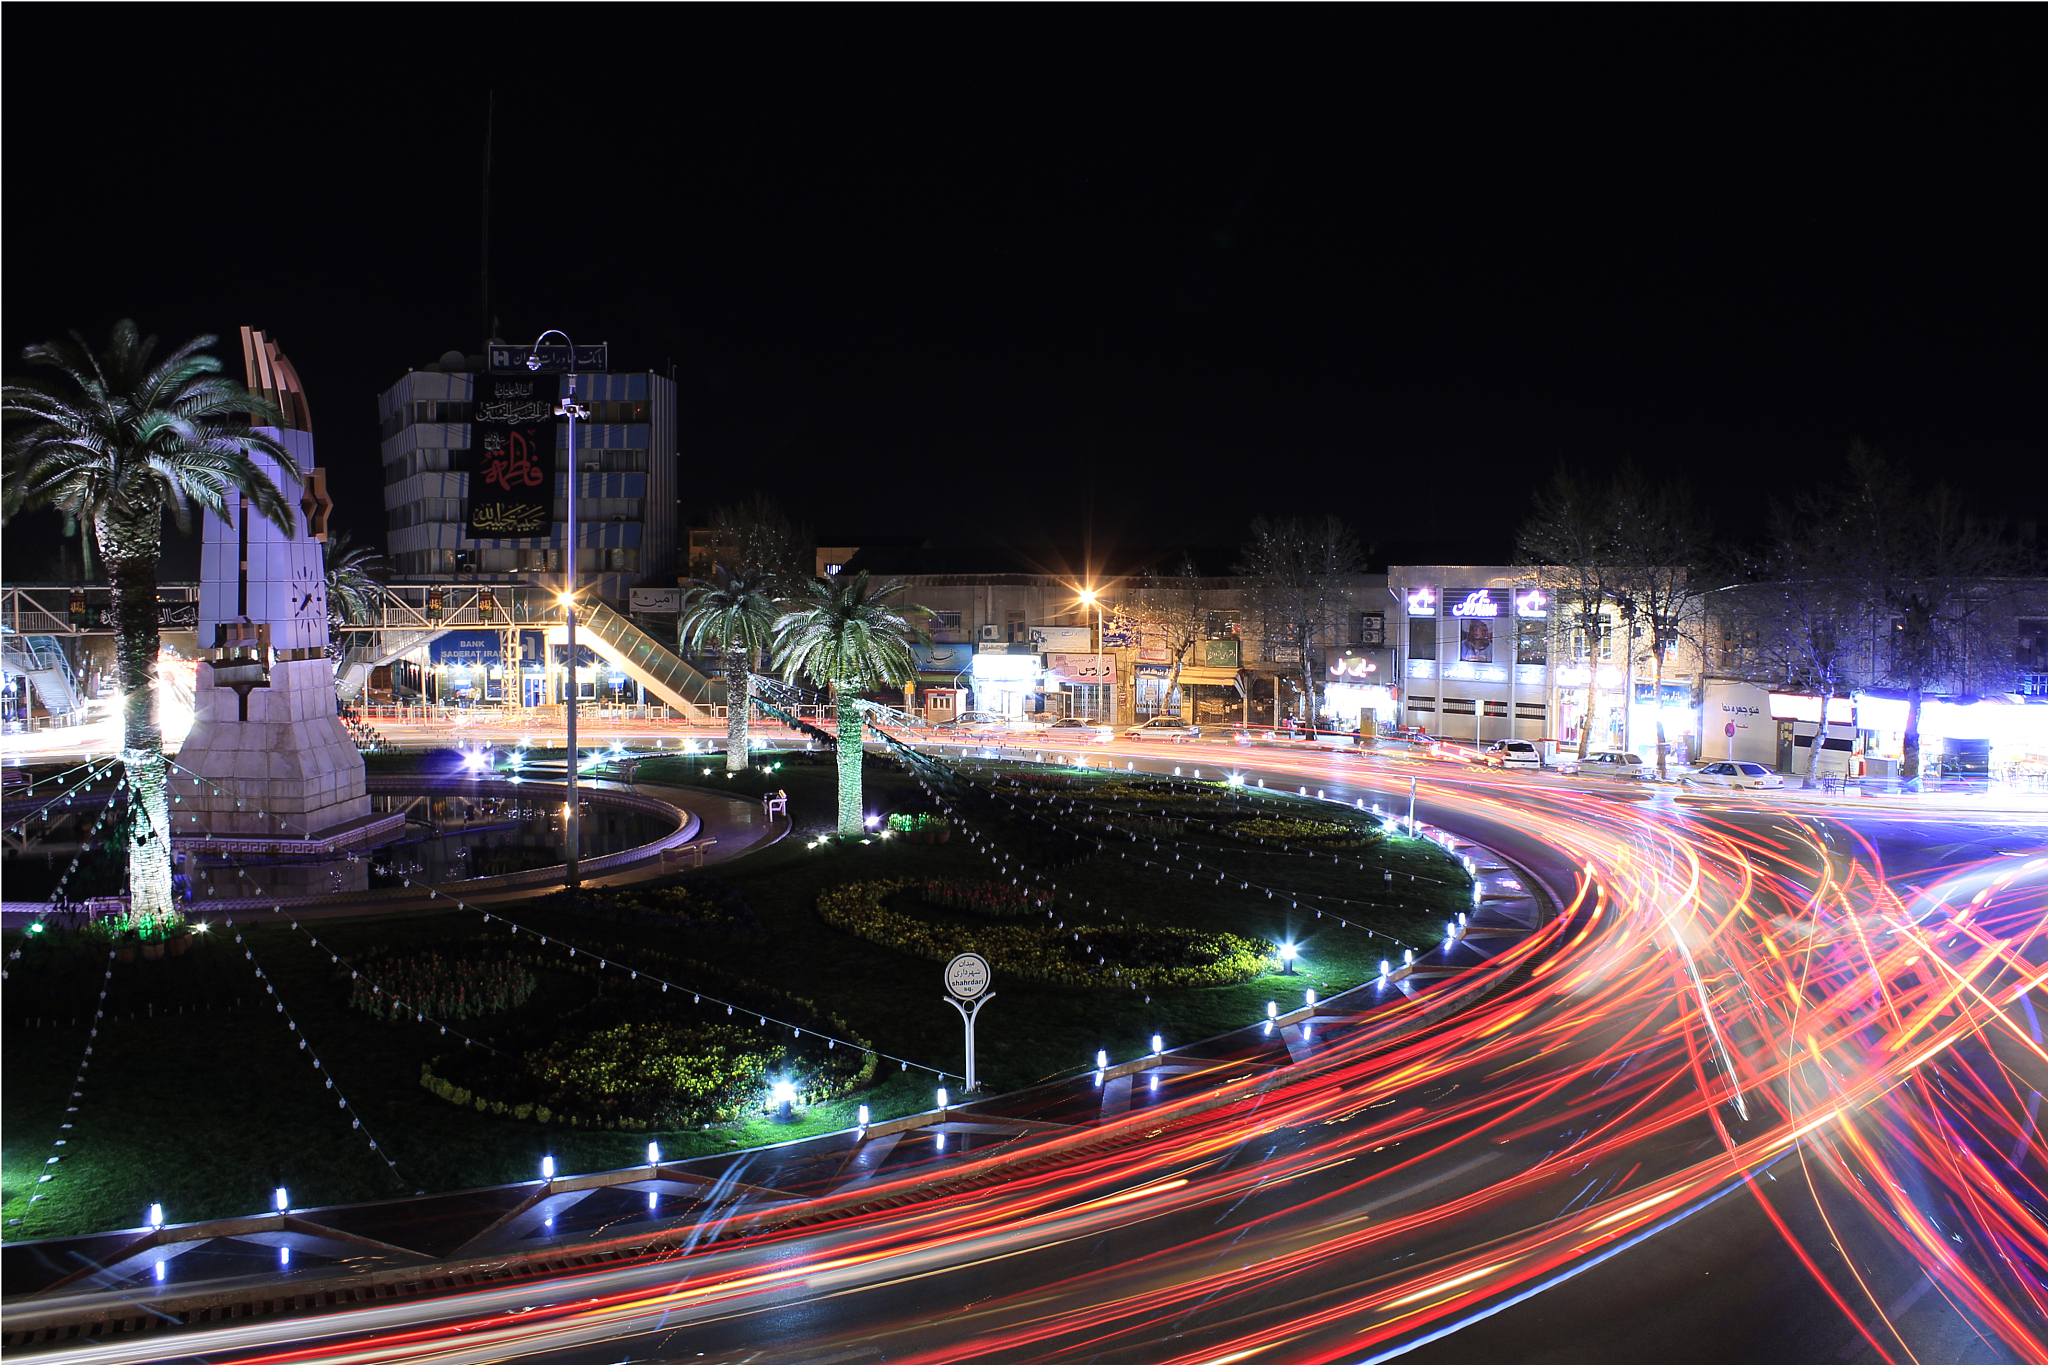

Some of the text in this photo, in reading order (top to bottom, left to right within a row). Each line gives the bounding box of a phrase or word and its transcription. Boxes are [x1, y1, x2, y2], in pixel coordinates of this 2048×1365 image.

[578, 348, 603, 368] بانک
[634, 594, 674, 608] امین
[460, 640, 485, 648] BANK
[441, 650, 481, 658] SADERAT
[1721, 702, 1731, 712] نما
[1749, 705, 1760, 716] فتو
[958, 960, 975, 968] میدان
[953, 969, 981, 978] شهرداری
[952, 979, 984, 987] shahrdari
